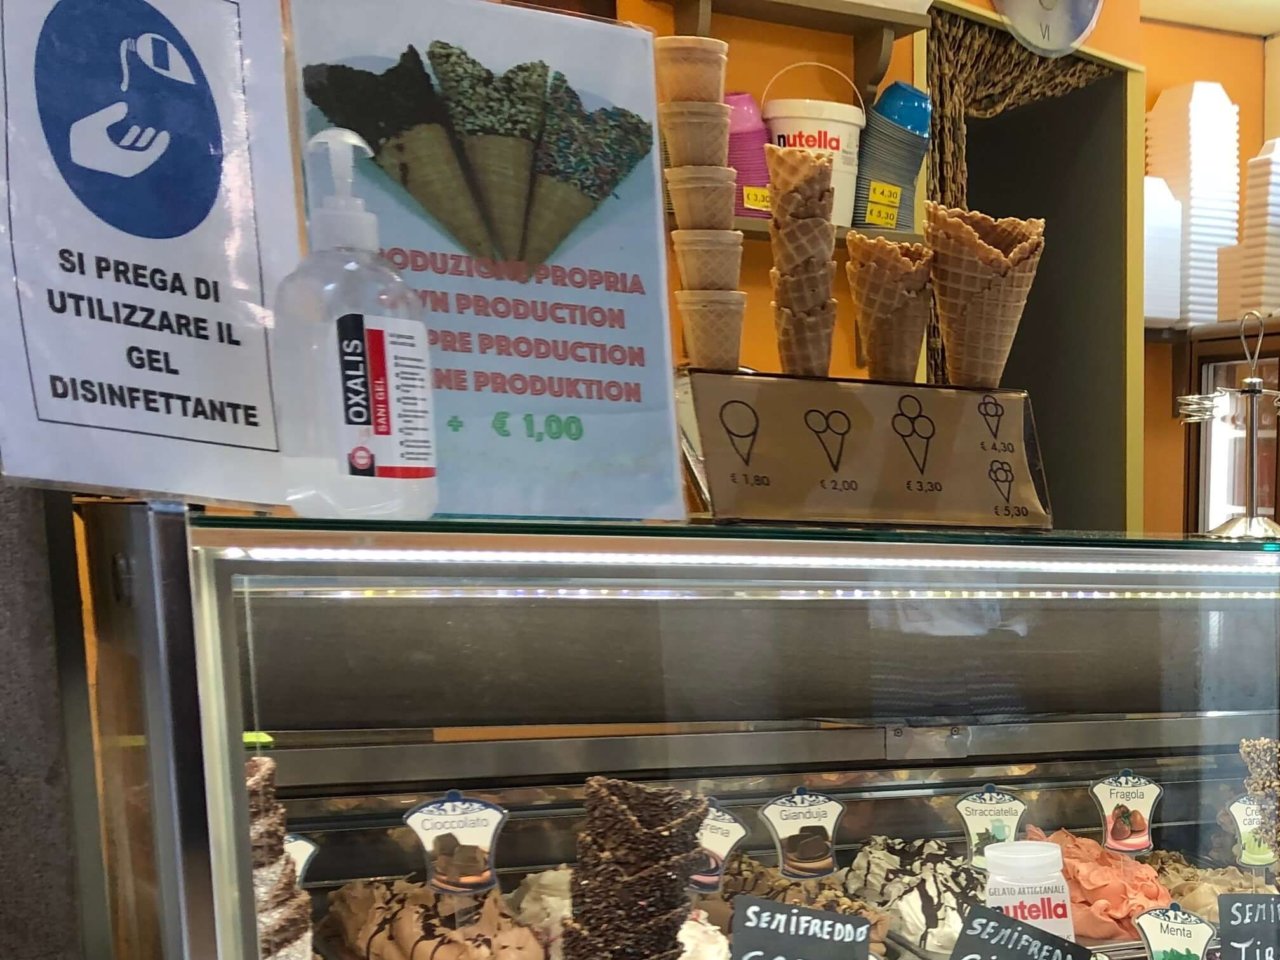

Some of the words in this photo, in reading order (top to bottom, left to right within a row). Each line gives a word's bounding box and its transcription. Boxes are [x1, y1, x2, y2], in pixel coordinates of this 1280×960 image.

[777, 130, 841, 151] nutella
[879, 188, 898, 200] 4,30
[58, 248, 86, 275] SI
[95, 255, 188, 296] PREGA
[194, 276, 221, 303] DI
[534, 263, 647, 296] PROPRIA
[47, 288, 210, 340] UTILIZZARE
[217, 321, 242, 346] IL
[455, 292, 626, 330] PRODUCTION
[477, 332, 646, 367] PRODUCTION
[126, 345, 180, 376] GEL
[342, 338, 369, 424] OXALIS
[473, 370, 642, 404] PRODUKTION
[49, 374, 260, 427] DISINFETTANTE
[491, 411, 511, 438] €
[522, 413, 584, 443] 1,00
[991, 441, 1015, 453] 4,30
[730, 472, 739, 486] €
[742, 473, 770, 488] 1,80
[819, 479, 828, 491] €
[830, 479, 859, 492] 2,00
[906, 481, 913, 492] €
[914, 480, 943, 493] 3,30
[1003, 505, 1029, 518] 5,30
[1109, 788, 1145, 801] Fragola
[779, 809, 828, 822] Gianduja
[964, 806, 1018, 817] Stracciatella
[1245, 806, 1261, 818] Cre
[421, 815, 489, 831] Cioccolato
[1242, 818, 1261, 827] cara
[988, 887, 1016, 897] GELATO
[1017, 885, 1066, 896] ARTIGIANALE
[744, 905, 870, 943] SEMIFREDDO
[1159, 923, 1193, 939] Menta
